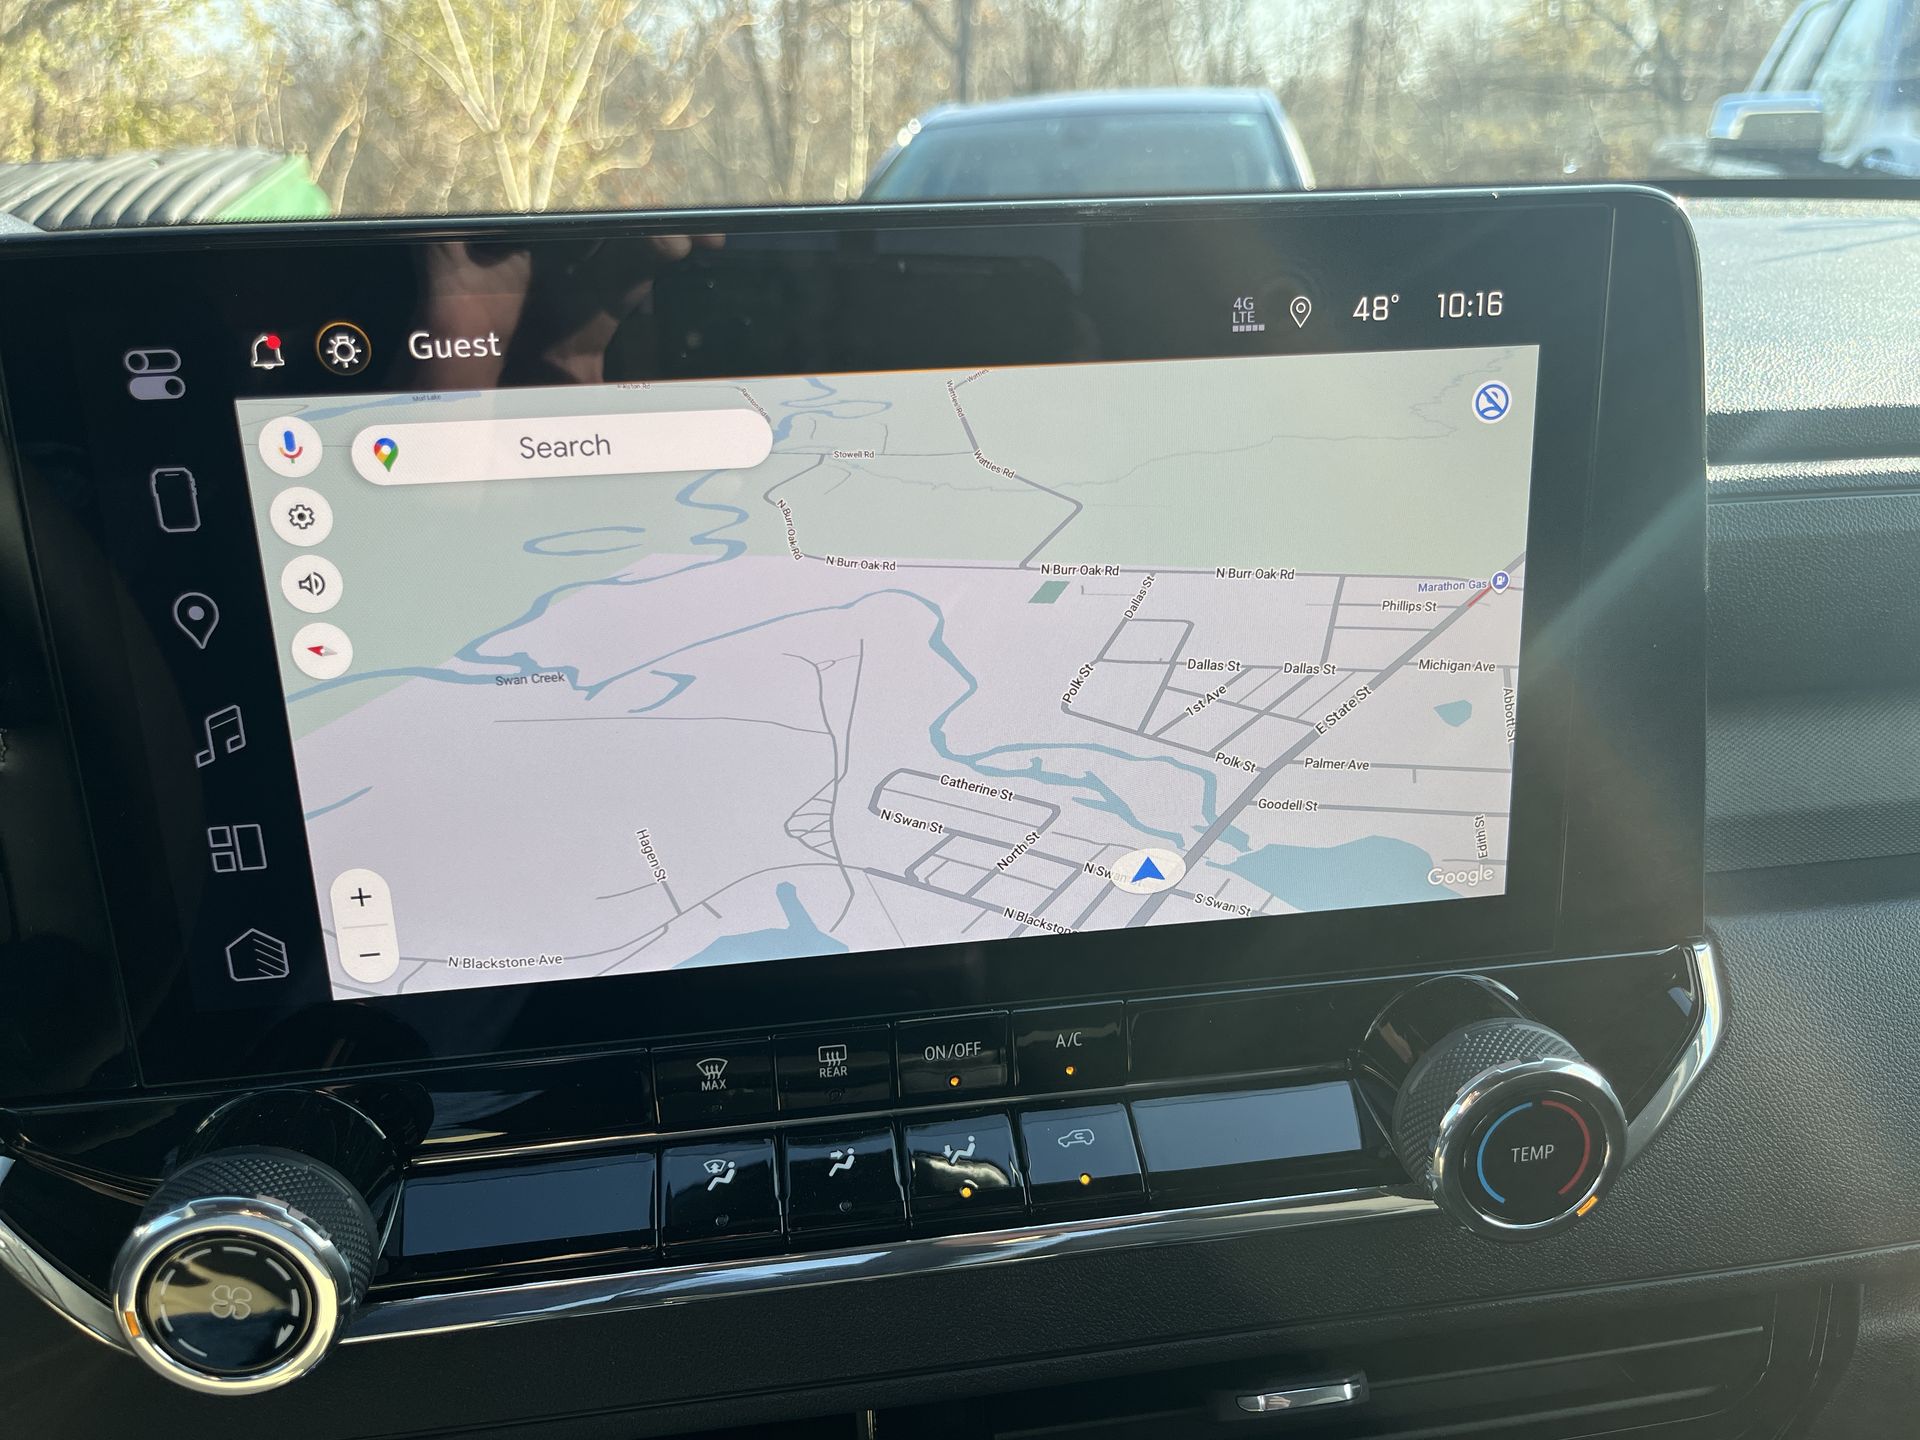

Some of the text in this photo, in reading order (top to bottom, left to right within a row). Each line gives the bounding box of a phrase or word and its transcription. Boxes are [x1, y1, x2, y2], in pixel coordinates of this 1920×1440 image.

[1233, 297, 1254, 310] 4G
[1353, 294, 1399, 321] 48°
[1437, 291, 1503, 318] 10:16
[1232, 311, 1256, 324] LTE
[408, 331, 502, 360] Guest
[519, 434, 611, 460] Search
[834, 451, 861, 459] Stowell
[974, 449, 1015, 479] Wattles Rd
[777, 500, 803, 560] N Burr Oak Rd
[826, 556, 896, 571] N Burr Oak Rd
[1041, 565, 1120, 576] N Burr Oak Rd
[1216, 568, 1295, 580] N Burr Oak Rd
[1418, 581, 1487, 593] Marathon Gas
[1124, 575, 1155, 619] Dallas St
[1382, 601, 1437, 613] Phillips St
[1187, 659, 1241, 672] Dallas St
[1283, 663, 1336, 675] Dallas St
[1418, 660, 1496, 672] Michigan Ave
[495, 672, 565, 686] Swan Creek
[1063, 664, 1094, 704] Polk St
[1186, 685, 1227, 716] 1st Ave
[1503, 688, 1515, 727] Abbott
[1316, 686, 1372, 735] E State St
[1215, 753, 1256, 773] Polk St
[1305, 758, 1369, 770] Palmer Ave
[940, 775, 1013, 802] Catherine St
[1258, 799, 1318, 812] Goodell St
[881, 810, 943, 834] N Swan St
[1475, 815, 1488, 858] Edith St
[637, 828, 667, 882] Hagen St
[997, 832, 1040, 870] North St
[1084, 863, 1094, 874] N
[1427, 865, 1494, 886] Google
[1004, 908, 1014, 918] N
[1195, 893, 1251, 917] S Swan St
[448, 955, 562, 969] N Blackstone Ave
[1055, 1032, 1083, 1049] A/C
[924, 1042, 981, 1062] ON/OFF
[819, 1065, 848, 1078] REAR
[701, 1079, 727, 1091] MAX
[1511, 1144, 1554, 1163] TEMP
